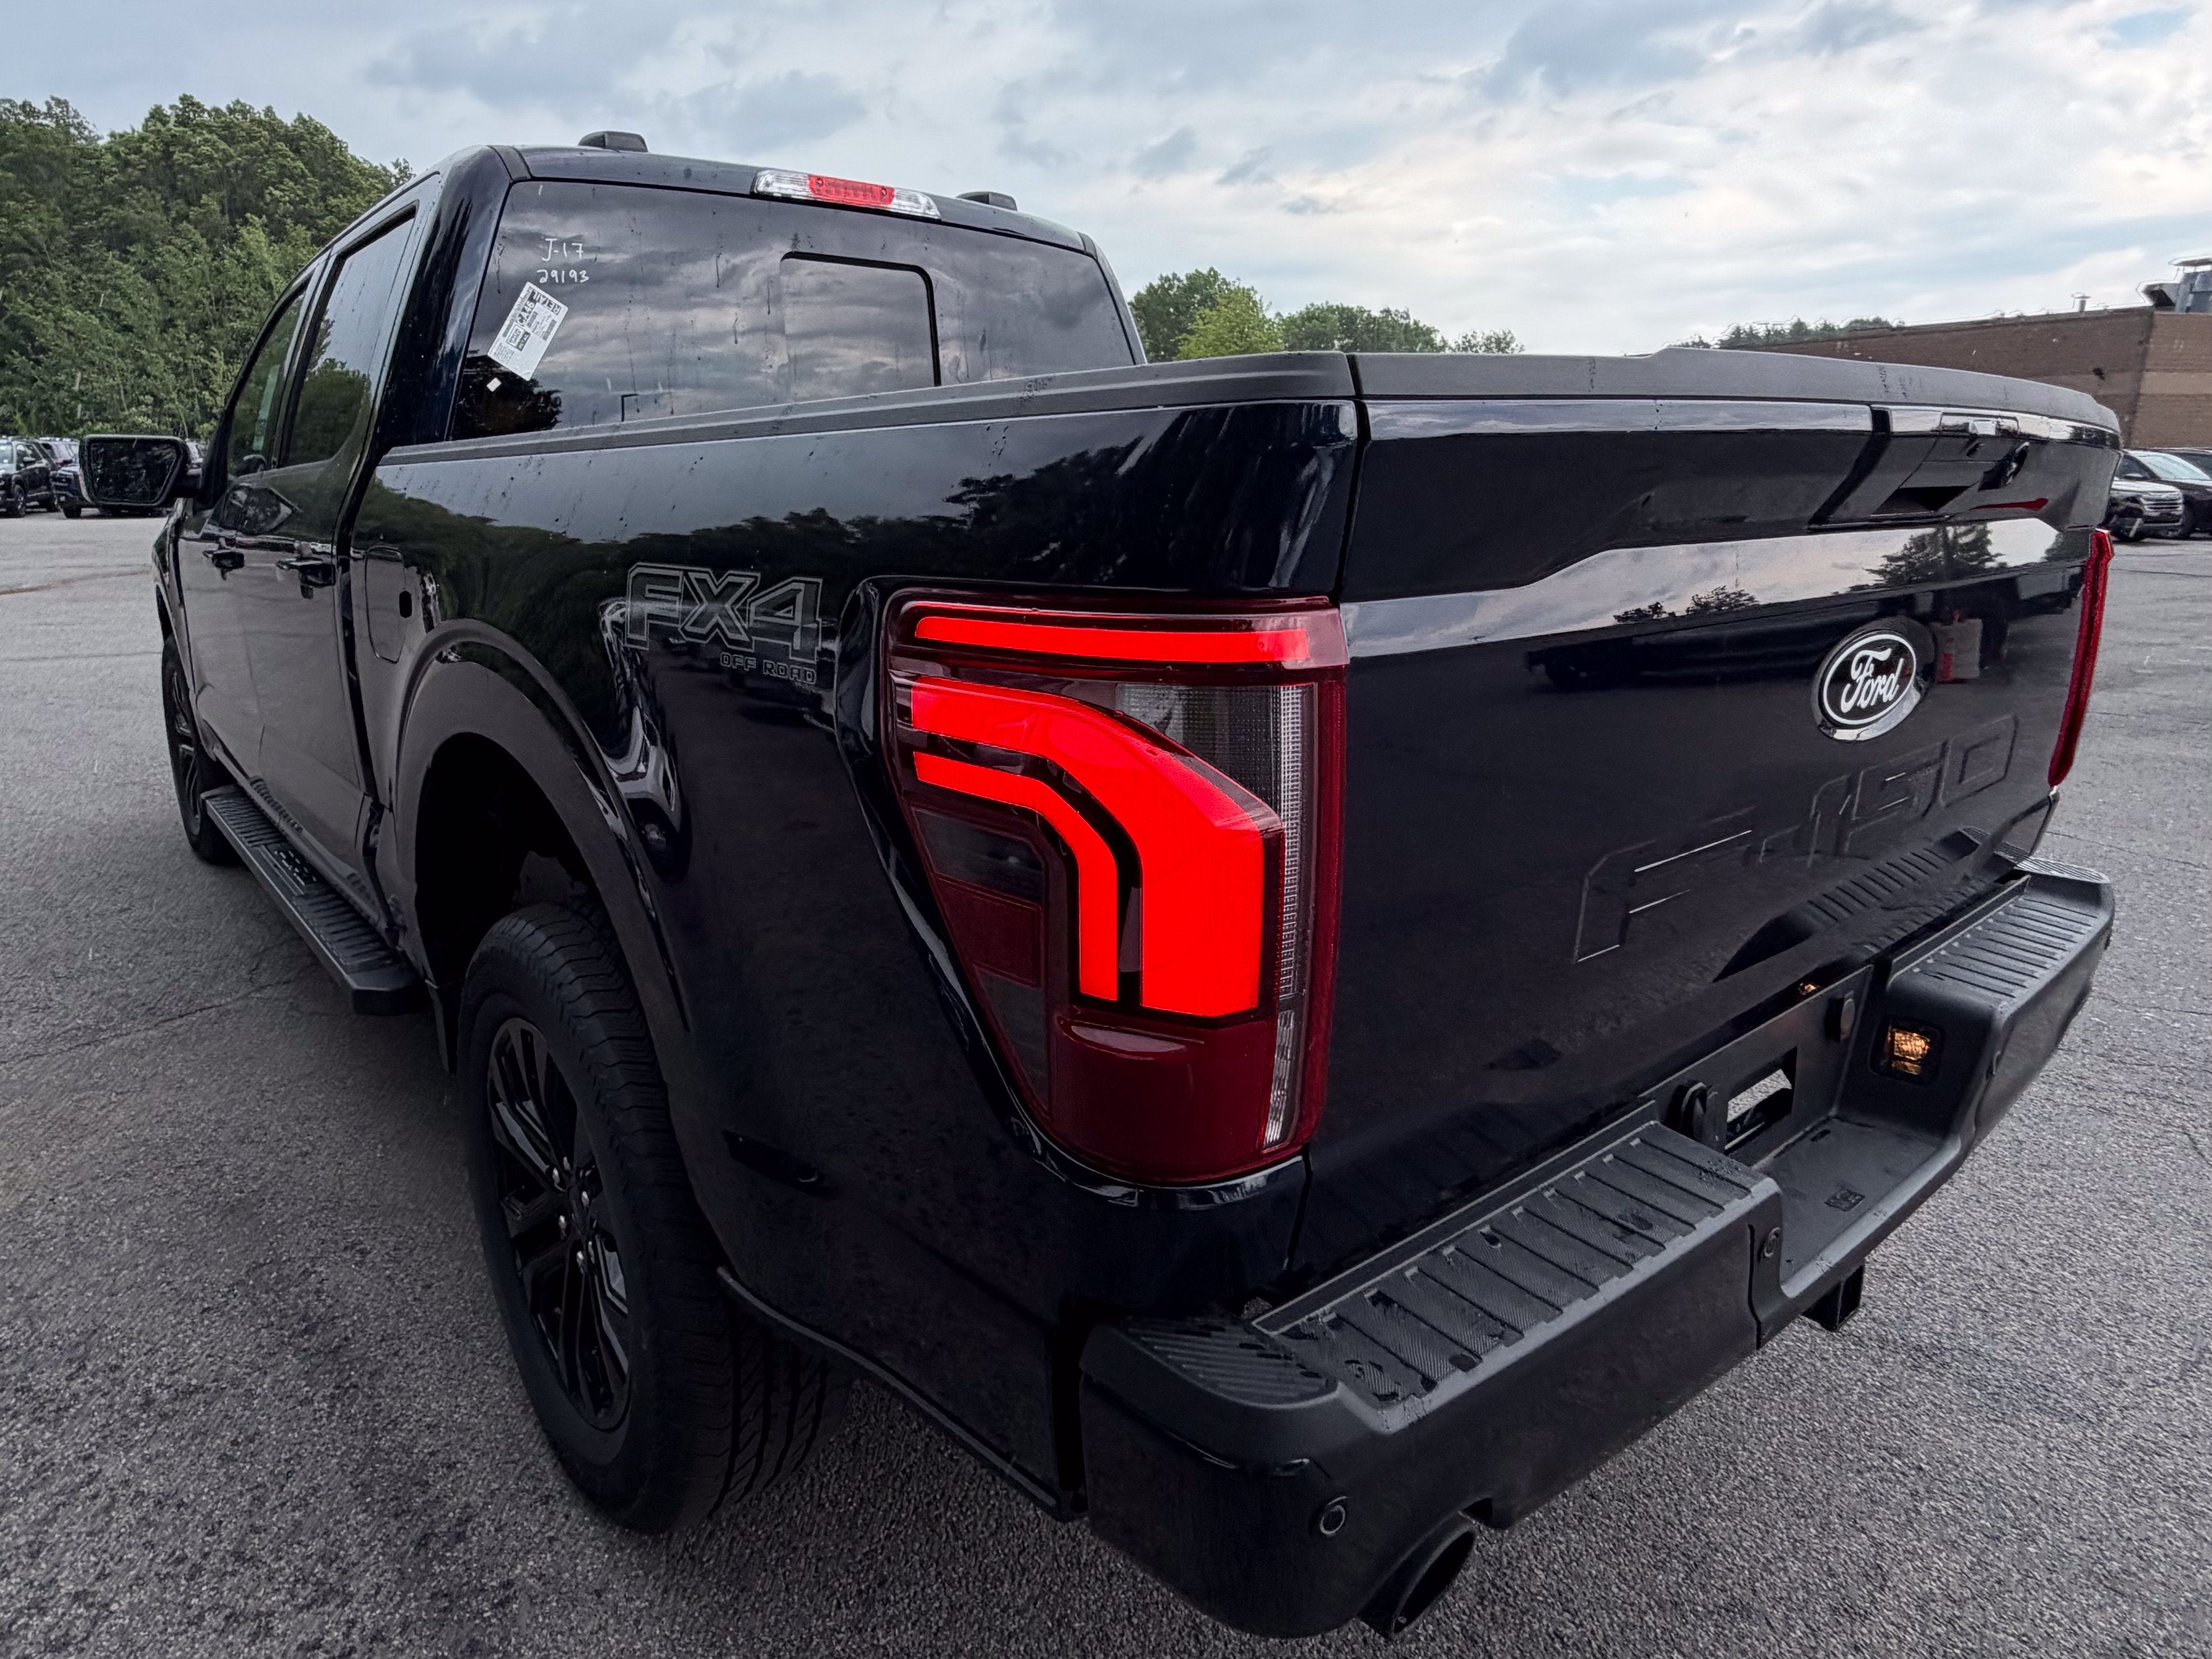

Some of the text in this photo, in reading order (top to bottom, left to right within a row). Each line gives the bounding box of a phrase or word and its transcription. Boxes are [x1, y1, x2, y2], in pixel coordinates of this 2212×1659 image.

[536, 269, 589, 283] 29193
[516, 299, 535, 327] CA46
[530, 289, 561, 314] RETAIL
[624, 562, 823, 663] FX4
[720, 651, 817, 685] OFF ROAD
[1841, 648, 1904, 713] Ford
